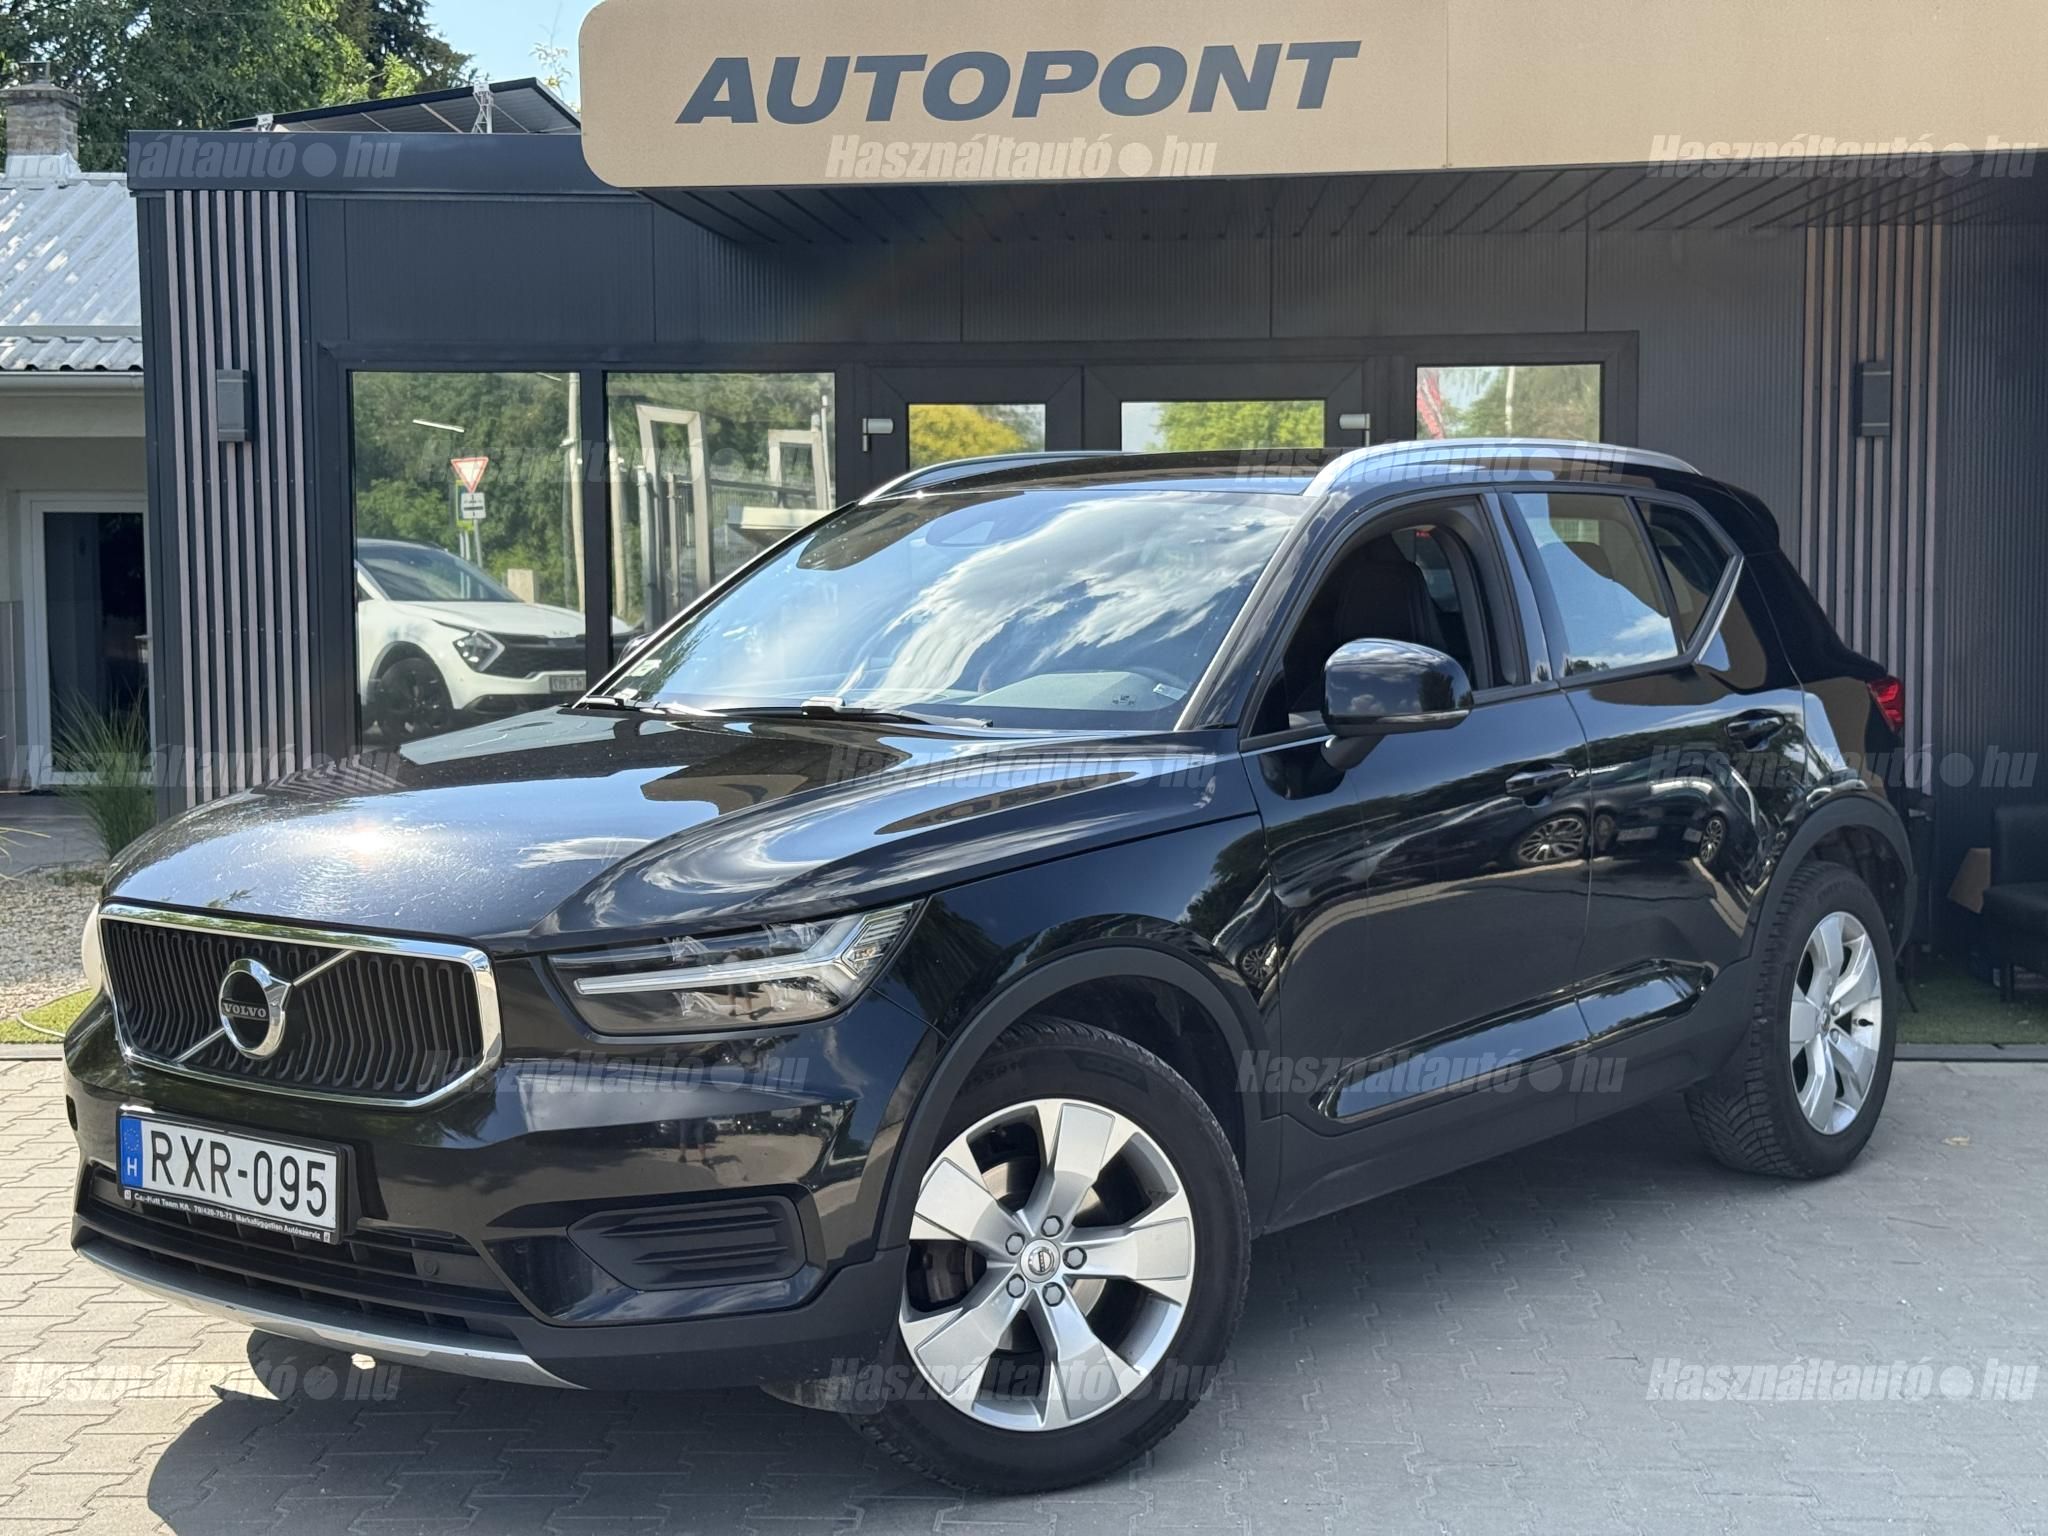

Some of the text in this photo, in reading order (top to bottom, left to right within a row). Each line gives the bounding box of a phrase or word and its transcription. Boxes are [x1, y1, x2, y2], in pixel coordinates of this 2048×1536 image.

[675, 41, 1361, 124] AUTOPONT
[223, 1003, 266, 1018] VOLVO
[126, 1157, 138, 1178] H
[151, 1130, 327, 1218] RXR-095
[284, 1225, 321, 1240] Autószerviz
